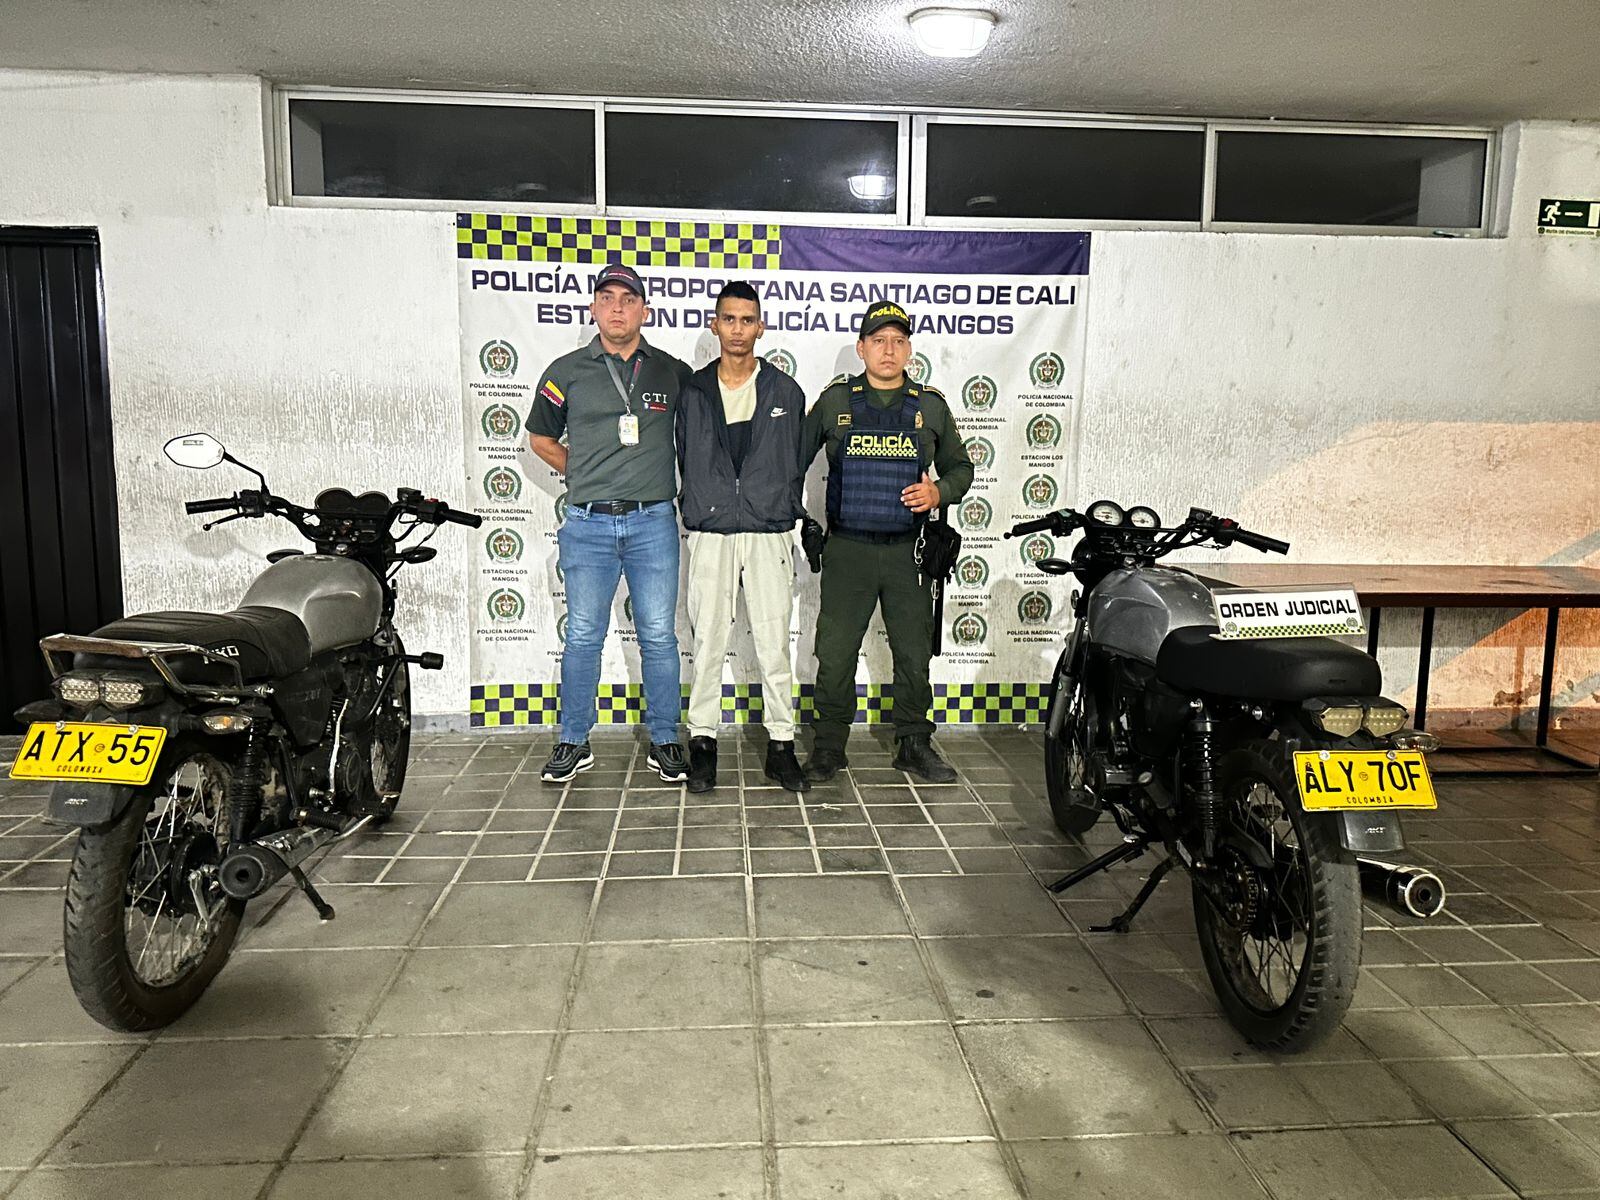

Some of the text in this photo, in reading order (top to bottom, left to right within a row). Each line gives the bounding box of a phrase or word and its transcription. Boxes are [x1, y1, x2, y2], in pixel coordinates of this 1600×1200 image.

[472, 265, 582, 294] POLICÍA
[830, 283, 971, 305] SANTIAGO
[977, 285, 1012, 305] DE
[1016, 285, 1076, 305] CALI
[763, 305, 829, 332] LICÍA
[835, 313, 864, 333] LO
[908, 314, 1013, 334] ANGOS
[642, 392, 667, 404] CTI
[850, 432, 913, 448] POLICÍA
[1219, 599, 1357, 619] ORDEN JUDICIAL
[24, 731, 155, 766] ATX 55
[56, 765, 103, 774] COLOMBIA
[1305, 761, 1420, 793] ALY 70F
[1346, 796, 1394, 804] COLOMBIA
